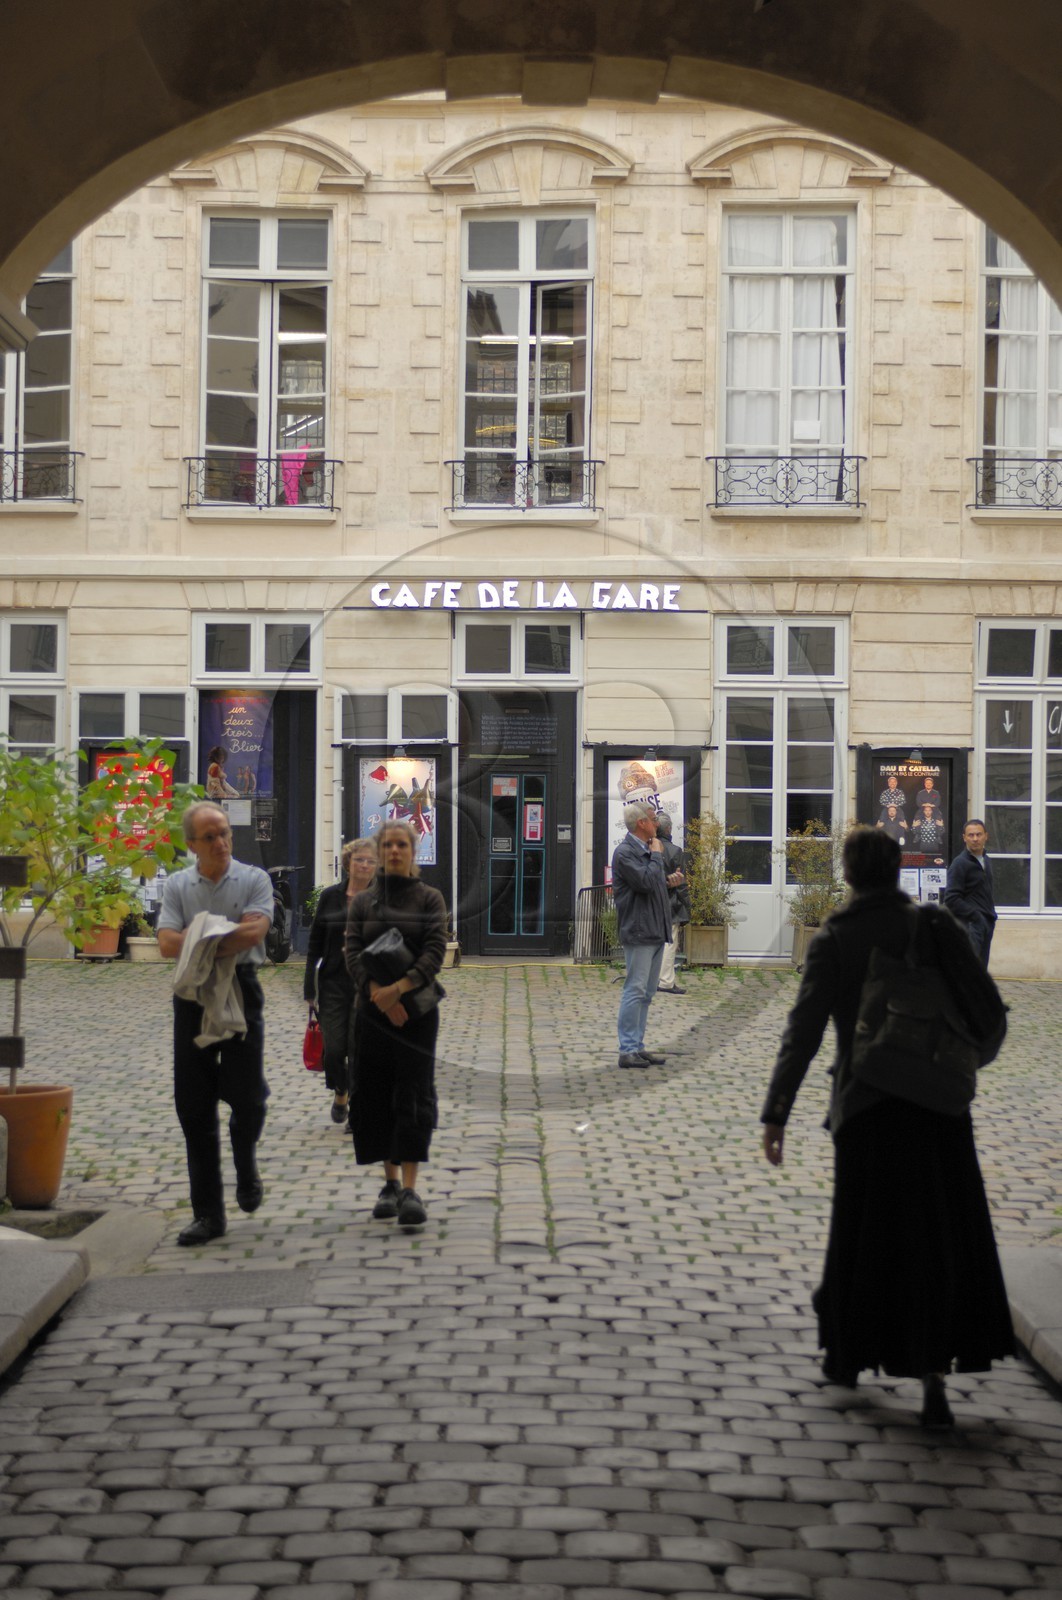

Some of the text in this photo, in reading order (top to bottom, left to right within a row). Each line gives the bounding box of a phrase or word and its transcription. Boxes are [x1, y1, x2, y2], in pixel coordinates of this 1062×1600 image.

[371, 581, 681, 610] CAFE DE LA GARE
[228, 706, 247, 714] un
[223, 715, 254, 726] deux
[229, 738, 263, 754] Blier
